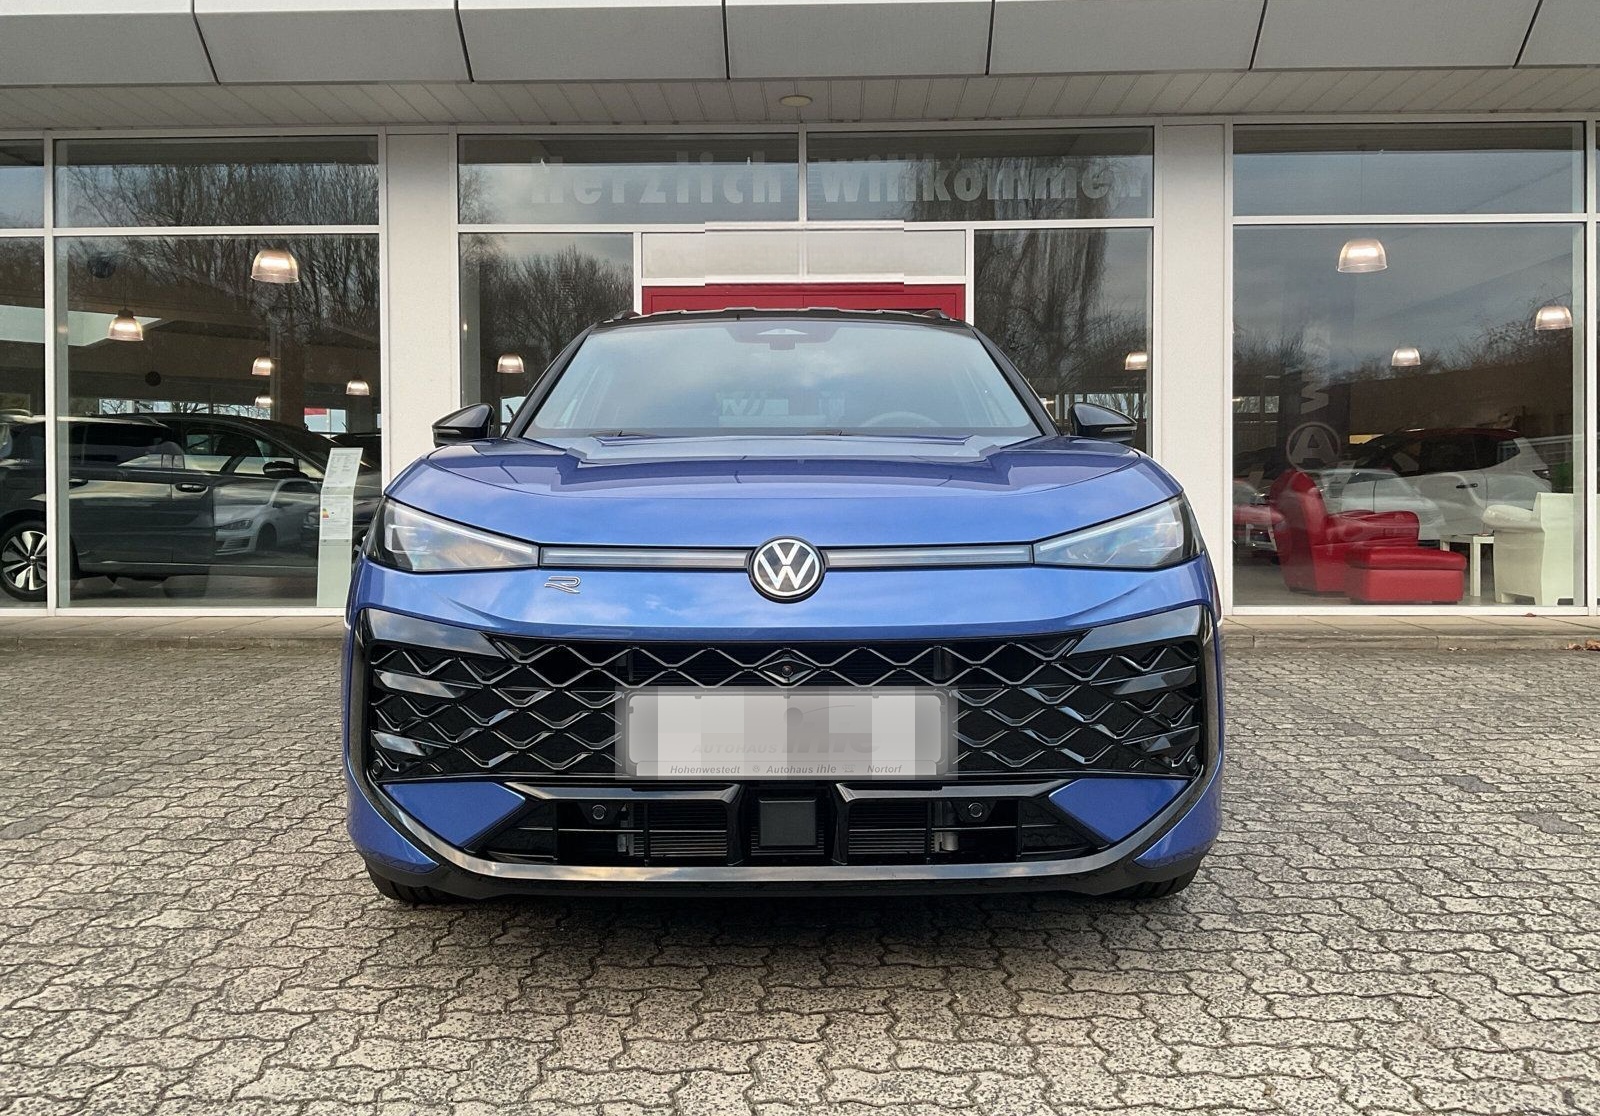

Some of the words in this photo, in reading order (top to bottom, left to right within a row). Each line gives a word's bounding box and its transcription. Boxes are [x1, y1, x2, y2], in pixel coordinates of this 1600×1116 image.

[531, 151, 781, 204] Herzlich
[670, 764, 741, 774] Hohenwestedt
[766, 765, 814, 774] Autohaus
[816, 764, 837, 773] ihle
[867, 764, 903, 774] Nortorf
